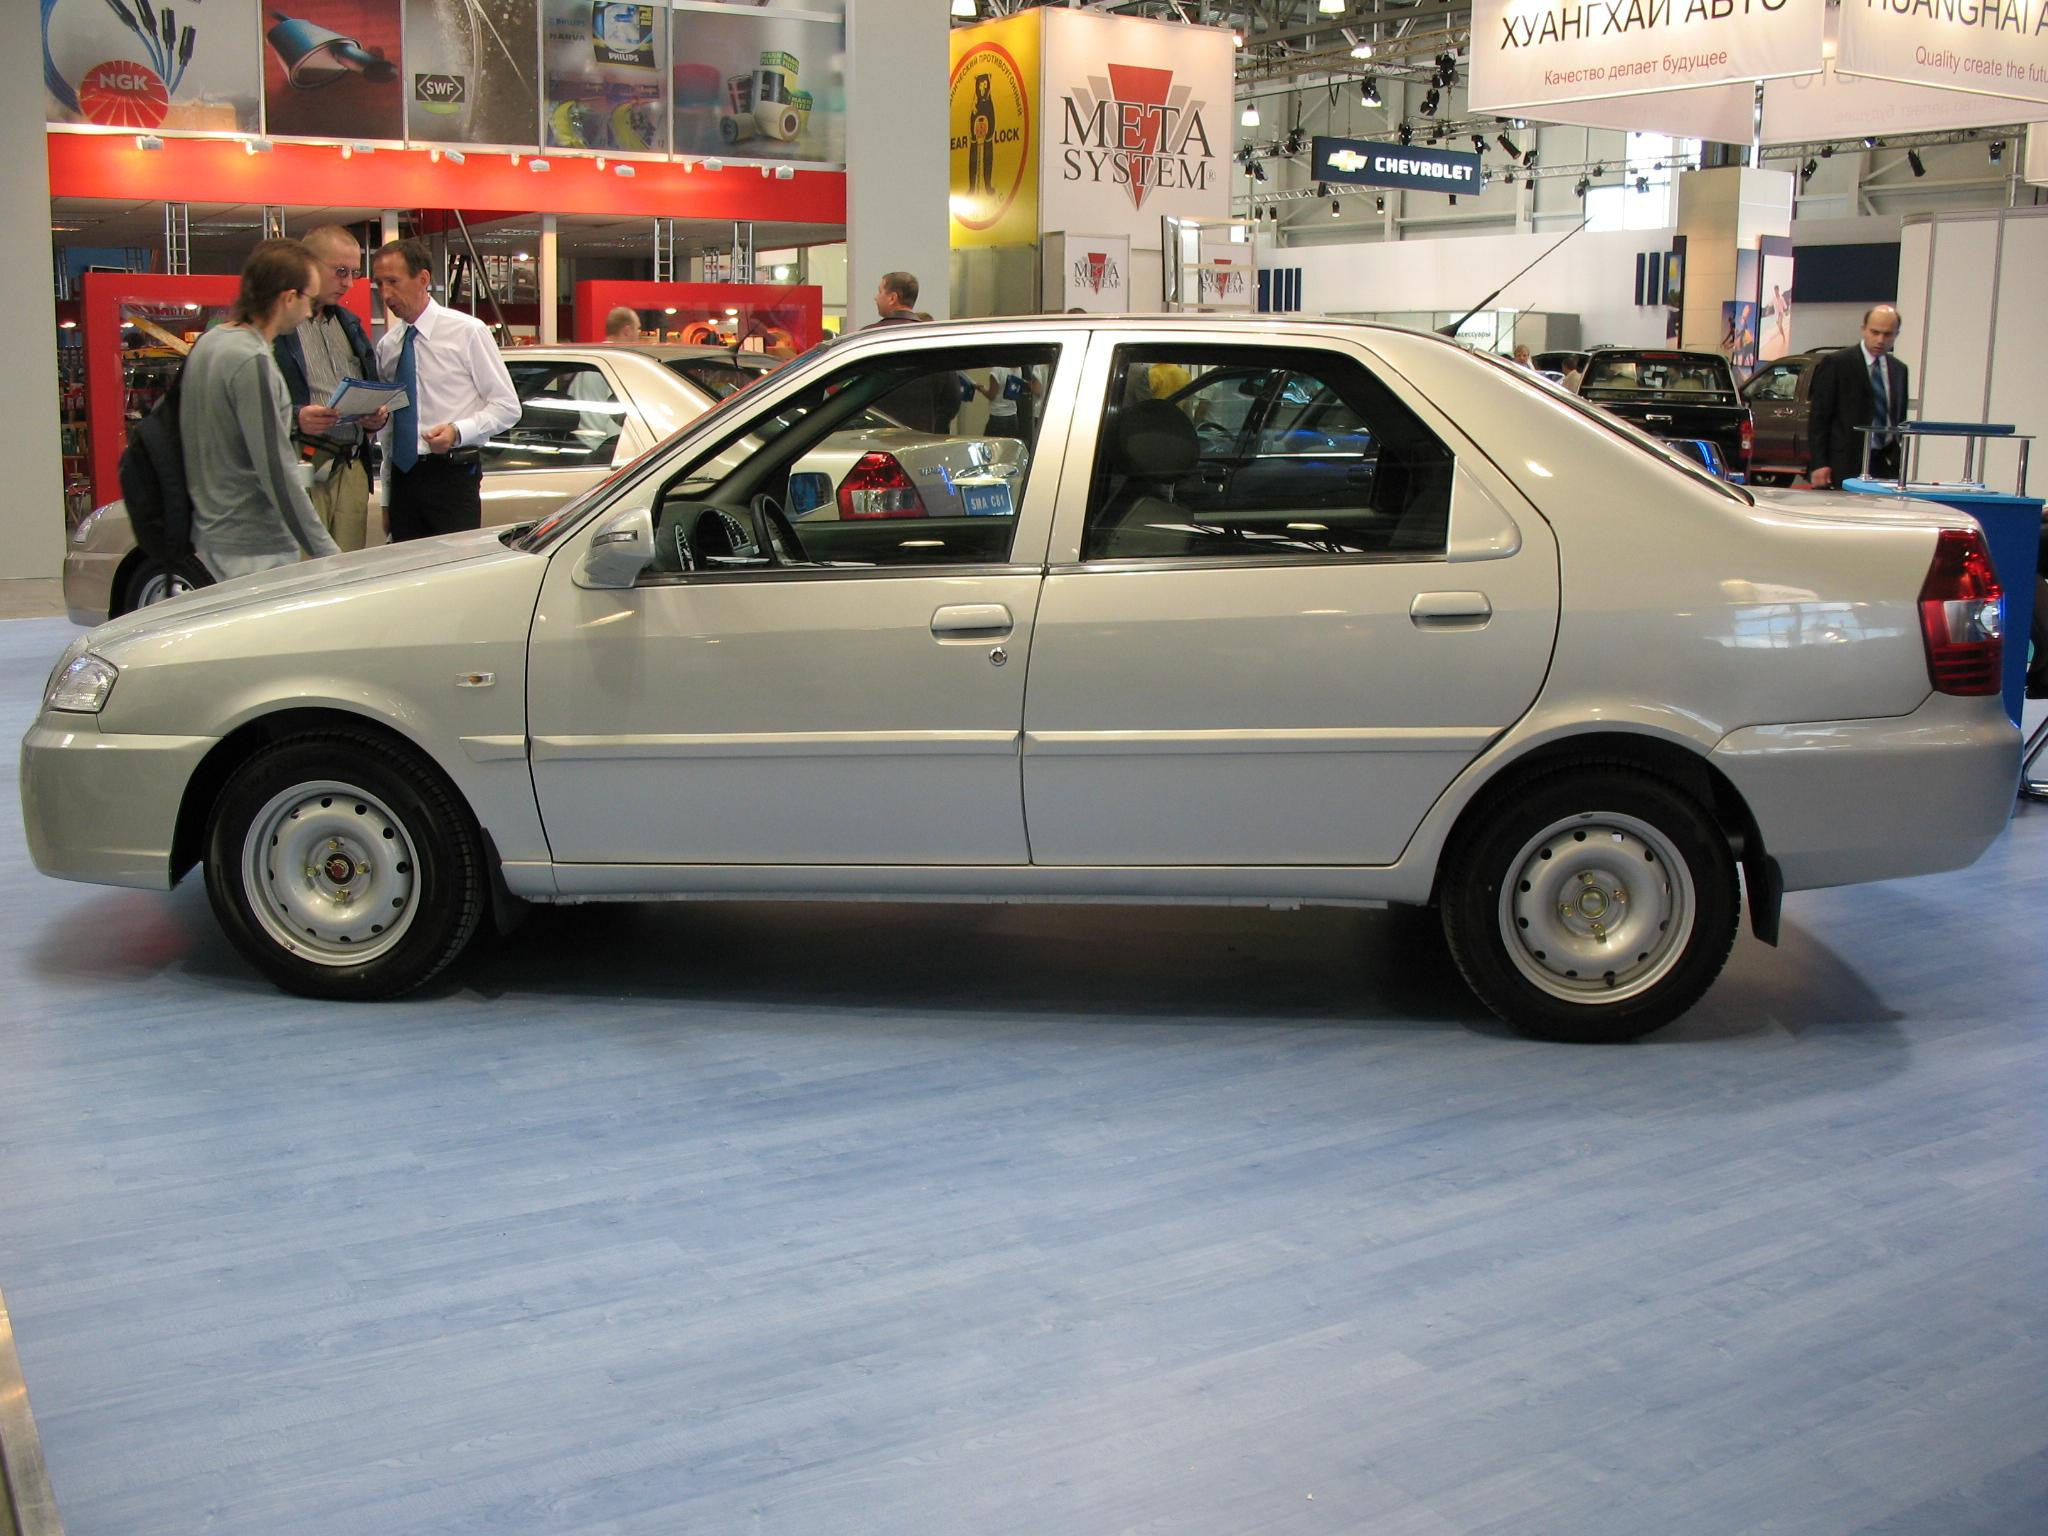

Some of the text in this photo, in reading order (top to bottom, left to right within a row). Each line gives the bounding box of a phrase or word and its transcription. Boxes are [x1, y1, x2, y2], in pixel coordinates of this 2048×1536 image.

[1867, 0, 2028, 34] ANGHAI
[608, 51, 640, 62] PHILIPS
[1544, 50, 1727, 86] Качество делает будущее
[1916, 46, 1960, 74] Quality
[1964, 58, 2002, 76] create
[2006, 61, 2025, 79] the
[100, 73, 149, 91] NGK
[426, 81, 454, 95] SWF
[950, 128, 1019, 150] EAR LOCK
[1059, 96, 1215, 158] META
[1063, 149, 1208, 190] SYSTEM
[1375, 157, 1473, 181] CHEVROLET
[970, 496, 989, 510] SMA
